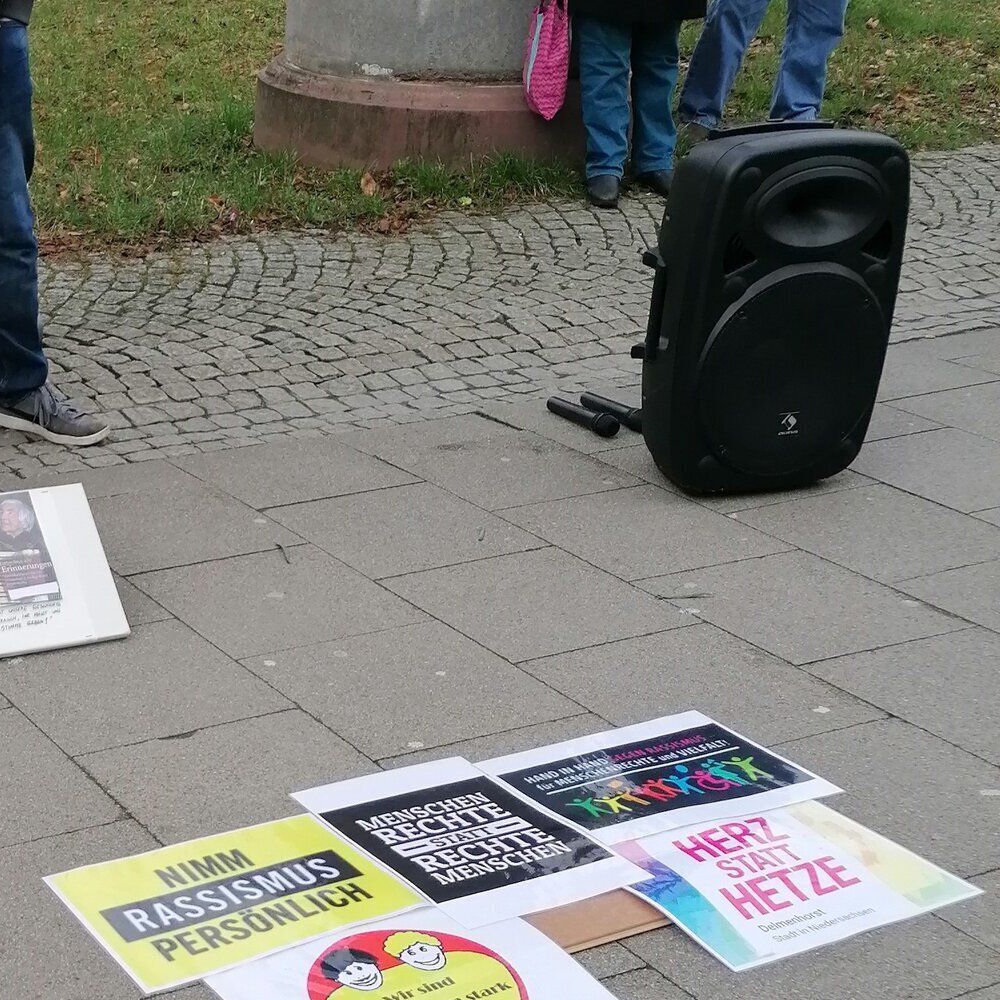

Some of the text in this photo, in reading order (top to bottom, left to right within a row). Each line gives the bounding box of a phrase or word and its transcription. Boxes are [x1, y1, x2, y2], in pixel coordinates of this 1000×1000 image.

[1, 561, 53, 573] Erinnerungen
[524, 770, 559, 784] HAND
[558, 766, 575, 777] IN
[573, 757, 609, 772] HAND
[609, 747, 648, 763] GEGEN
[535, 780, 558, 792] für
[556, 755, 659, 788] MENSCHENRECHTE
[657, 750, 679, 763] und
[355, 791, 491, 831] MENSCHEN
[371, 801, 512, 845] RECHTE
[411, 826, 556, 873] RECHTE
[428, 825, 495, 849] STATT
[672, 816, 791, 862] HERZ
[154, 848, 255, 889] NIMM
[431, 841, 572, 885] MENSCHEN
[716, 843, 802, 879] STATT
[123, 857, 342, 933] RASSISMUS
[719, 855, 862, 920] HETZE
[150, 882, 374, 962] PERSÖNLICH
[758, 908, 827, 933] Delmenhorst
[773, 906, 876, 943] Stadt in Niedersachsen
[417, 975, 456, 995] sind
